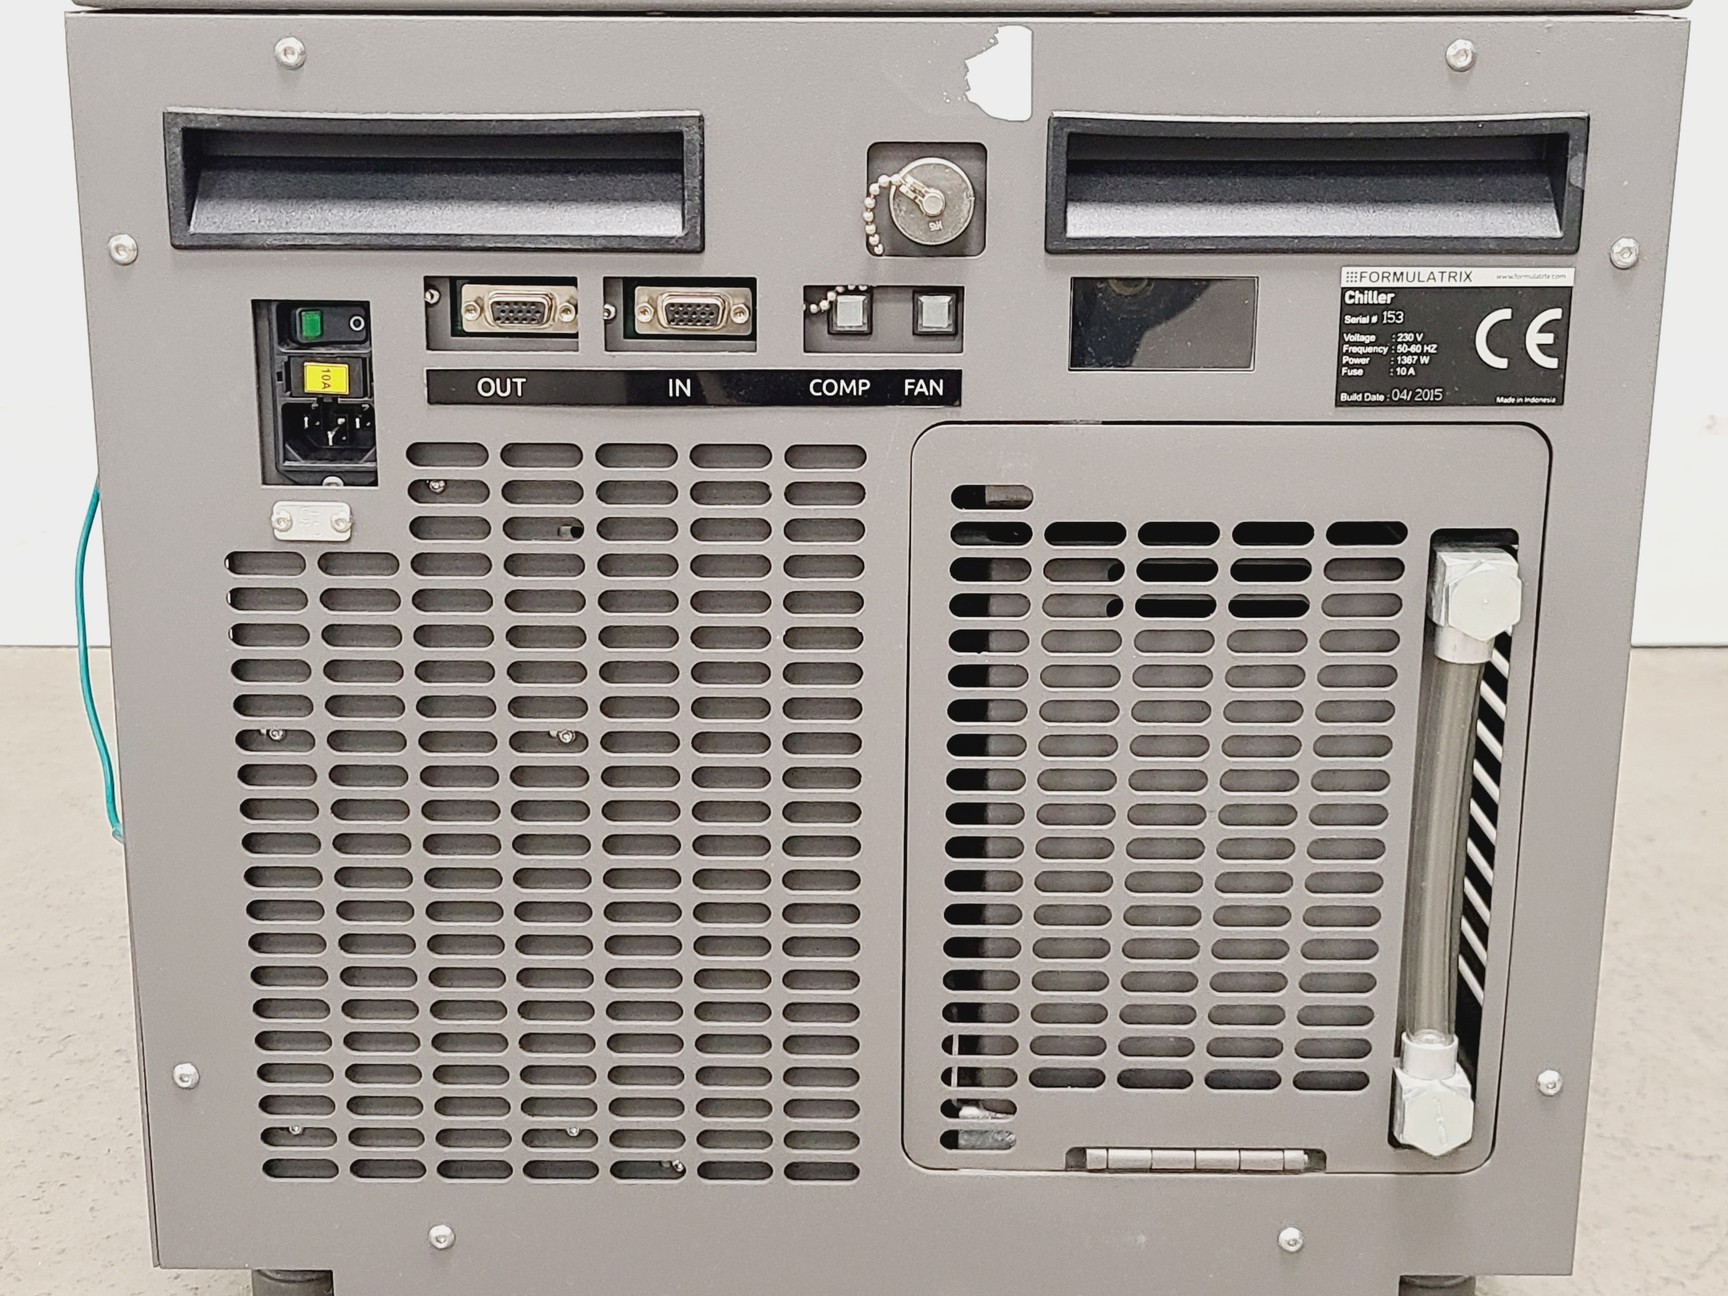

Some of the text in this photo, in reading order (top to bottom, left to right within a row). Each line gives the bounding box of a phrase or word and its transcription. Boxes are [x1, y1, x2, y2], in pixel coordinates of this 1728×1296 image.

[1359, 271, 1473, 283] FORMULATRIX
[1344, 290, 1395, 304] Chiller
[1344, 315, 1370, 324] Serial
[1382, 310, 1404, 324] 153
[1343, 333, 1376, 343] Voltage
[1342, 344, 1389, 355] Frequency
[1342, 356, 1371, 364] Power
[1341, 367, 1364, 376] Fuse
[476, 377, 527, 397] OUT
[668, 378, 691, 397] IN
[809, 379, 871, 396] COMP
[904, 379, 944, 396] FAN
[1340, 393, 1362, 402] Build
[1364, 393, 1385, 402] Date
